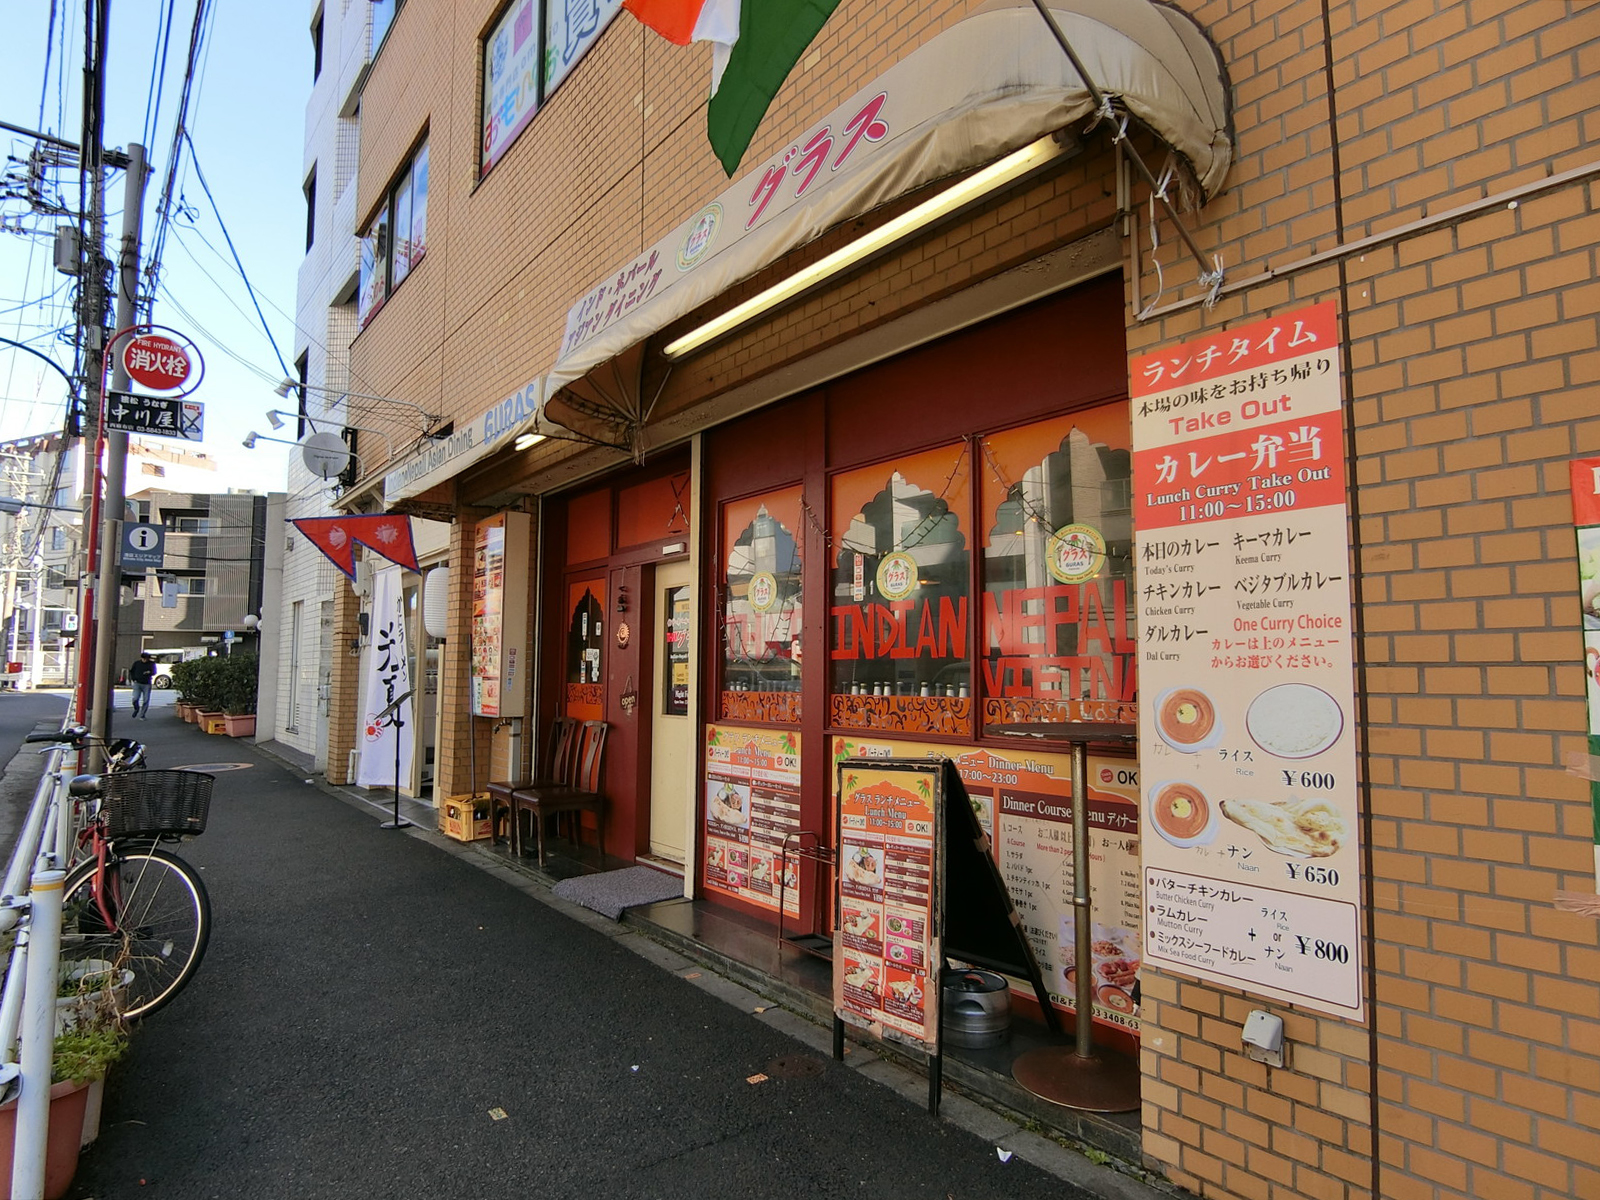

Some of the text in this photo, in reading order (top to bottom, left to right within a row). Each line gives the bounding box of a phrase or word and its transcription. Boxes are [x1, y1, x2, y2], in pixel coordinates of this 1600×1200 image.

[746, 91, 889, 231] グラス
[577, 250, 660, 322] インド・ネパール
[603, 268, 663, 328] ダイニング
[137, 340, 181, 353] FIRE HYDRANT
[1143, 321, 1317, 387] ランチタイム
[129, 347, 187, 378] 消火栓
[1137, 358, 1331, 418] 本場の味をお持ち帰り
[143, 398, 168, 409] うなぎ
[111, 403, 175, 429] 中川屋
[484, 383, 536, 445] GURAS
[1168, 394, 1292, 436] Take Out
[427, 445, 446, 471] Asian
[447, 427, 473, 457] Dining
[1155, 426, 1322, 485] カレー弁当
[1146, 465, 1331, 507] Lunch Curry Take Out
[1179, 489, 1295, 521] 11:00～15:00
[1233, 527, 1311, 551] キーマカレー
[1063, 546, 1088, 562] グラス
[1141, 538, 1219, 562] 本日のカレー
[1235, 552, 1282, 565] Keema Curry
[1144, 563, 1195, 576] Today's Curry
[1143, 580, 1221, 602] チキンカレー
[1234, 571, 1342, 595] ベジタブルカレー
[1145, 605, 1195, 617] Chicken Curry
[1237, 598, 1295, 611] Vegetable Curry
[983, 580, 1137, 656] NEPAL
[1233, 614, 1342, 633] One Curry Choice
[831, 596, 968, 660] INDIAN
[1145, 624, 1209, 643] ダルカレー
[1211, 636, 1340, 651] カレーは上のメニュー
[1146, 651, 1181, 662] Dal Curry
[1211, 654, 1334, 670] からお選びください。
[621, 695, 636, 709] open
[784, 757, 797, 768] OK!
[1218, 749, 1254, 762] ライス
[988, 756, 1022, 772] Dinner
[1024, 760, 1054, 775] Menu
[1235, 767, 1254, 776] Rice
[959, 769, 1018, 785] 17:00～23:00
[1282, 770, 1335, 790] ¥600
[854, 792, 921, 807] グラス ランチメニュー
[864, 805, 907, 819] Lunch Menu
[1002, 795, 1138, 829] Dinner Course enu ディナー
[915, 822, 928, 832] OK!
[1008, 824, 1023, 835] コース
[1010, 838, 1026, 848] Course
[1036, 842, 1048, 852] More
[1049, 845, 1060, 853] than
[1227, 845, 1253, 859] ナン
[1237, 861, 1260, 873] Naan
[1286, 862, 1339, 886] ¥650
[1155, 878, 1254, 903] バターチキンカレー
[1155, 890, 1215, 912] Butter Chicken Curry
[1157, 904, 1208, 922] ラムカレー
[1260, 907, 1288, 922] ライス
[1157, 918, 1203, 937] Mutton Curry
[1276, 922, 1290, 932] Rice
[1157, 931, 1256, 962] ミックスシーフードカレー
[1272, 933, 1282, 943] or
[1157, 945, 1215, 967] Mix Sea Food Curry
[1264, 945, 1286, 960] ナン
[1294, 935, 1349, 964] ¥800
[1274, 962, 1294, 973] Naan
